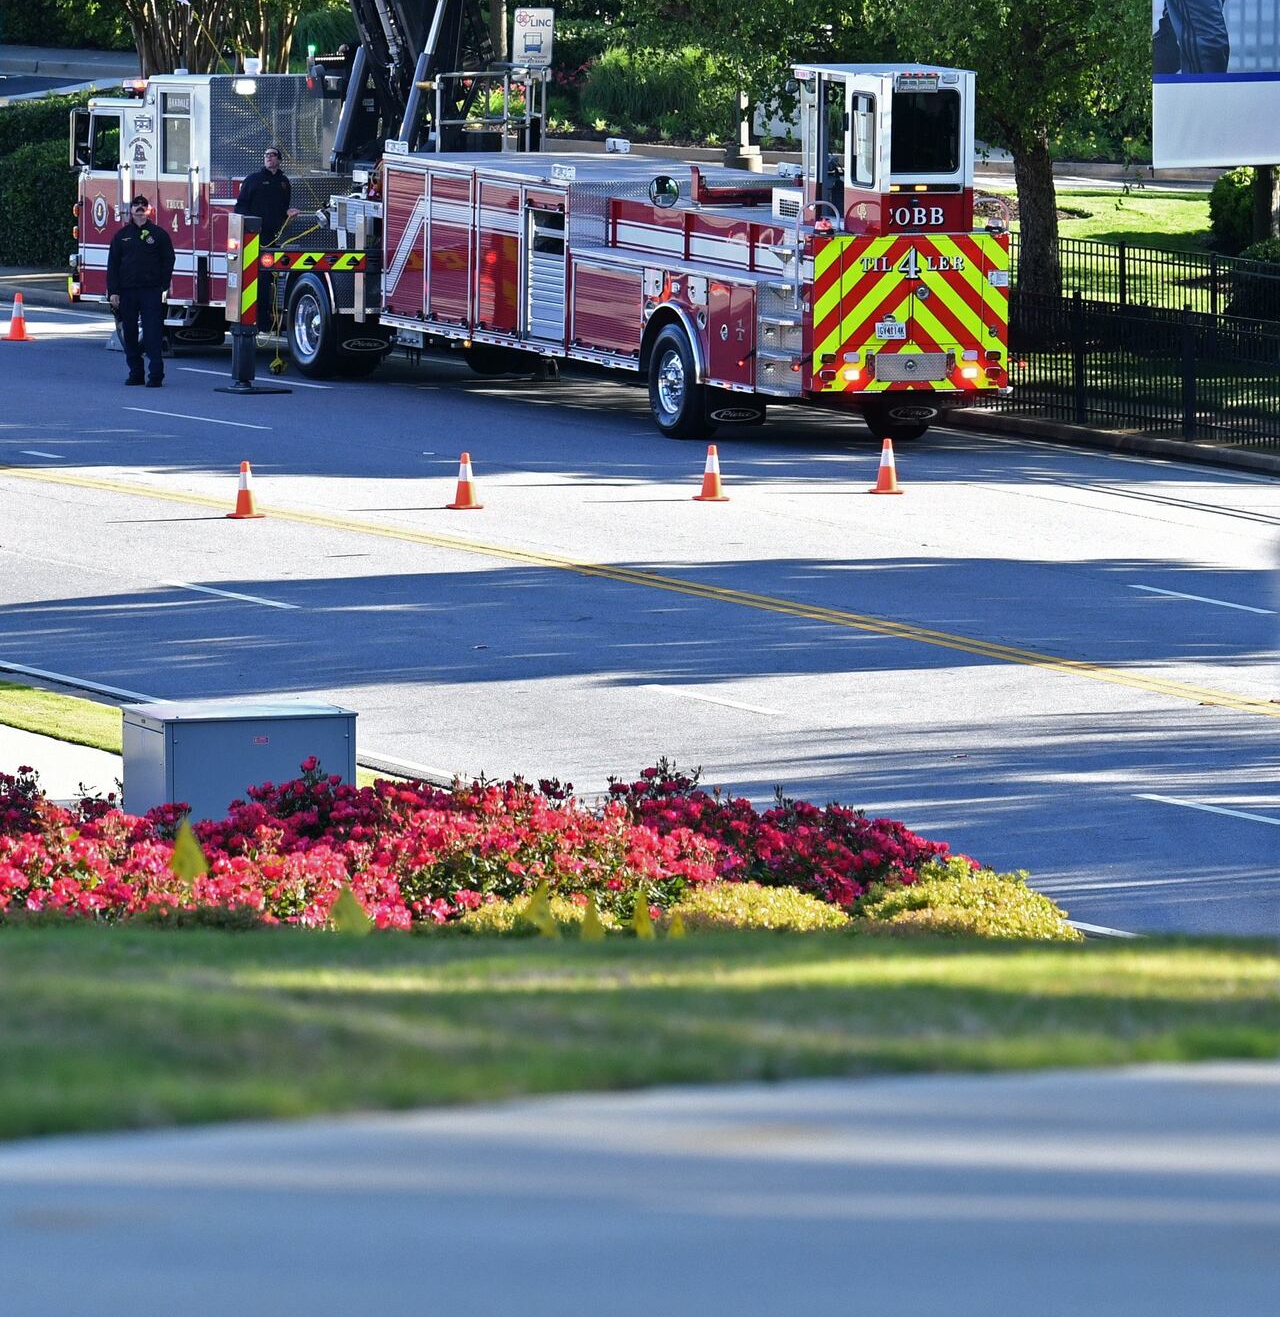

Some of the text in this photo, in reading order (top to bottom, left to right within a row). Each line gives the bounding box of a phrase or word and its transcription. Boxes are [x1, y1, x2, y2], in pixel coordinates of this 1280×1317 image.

[530, 18, 552, 27] LINC
[172, 214, 178, 232] 4
[888, 206, 945, 226] OBB
[860, 246, 965, 280] TIL 4 LER
